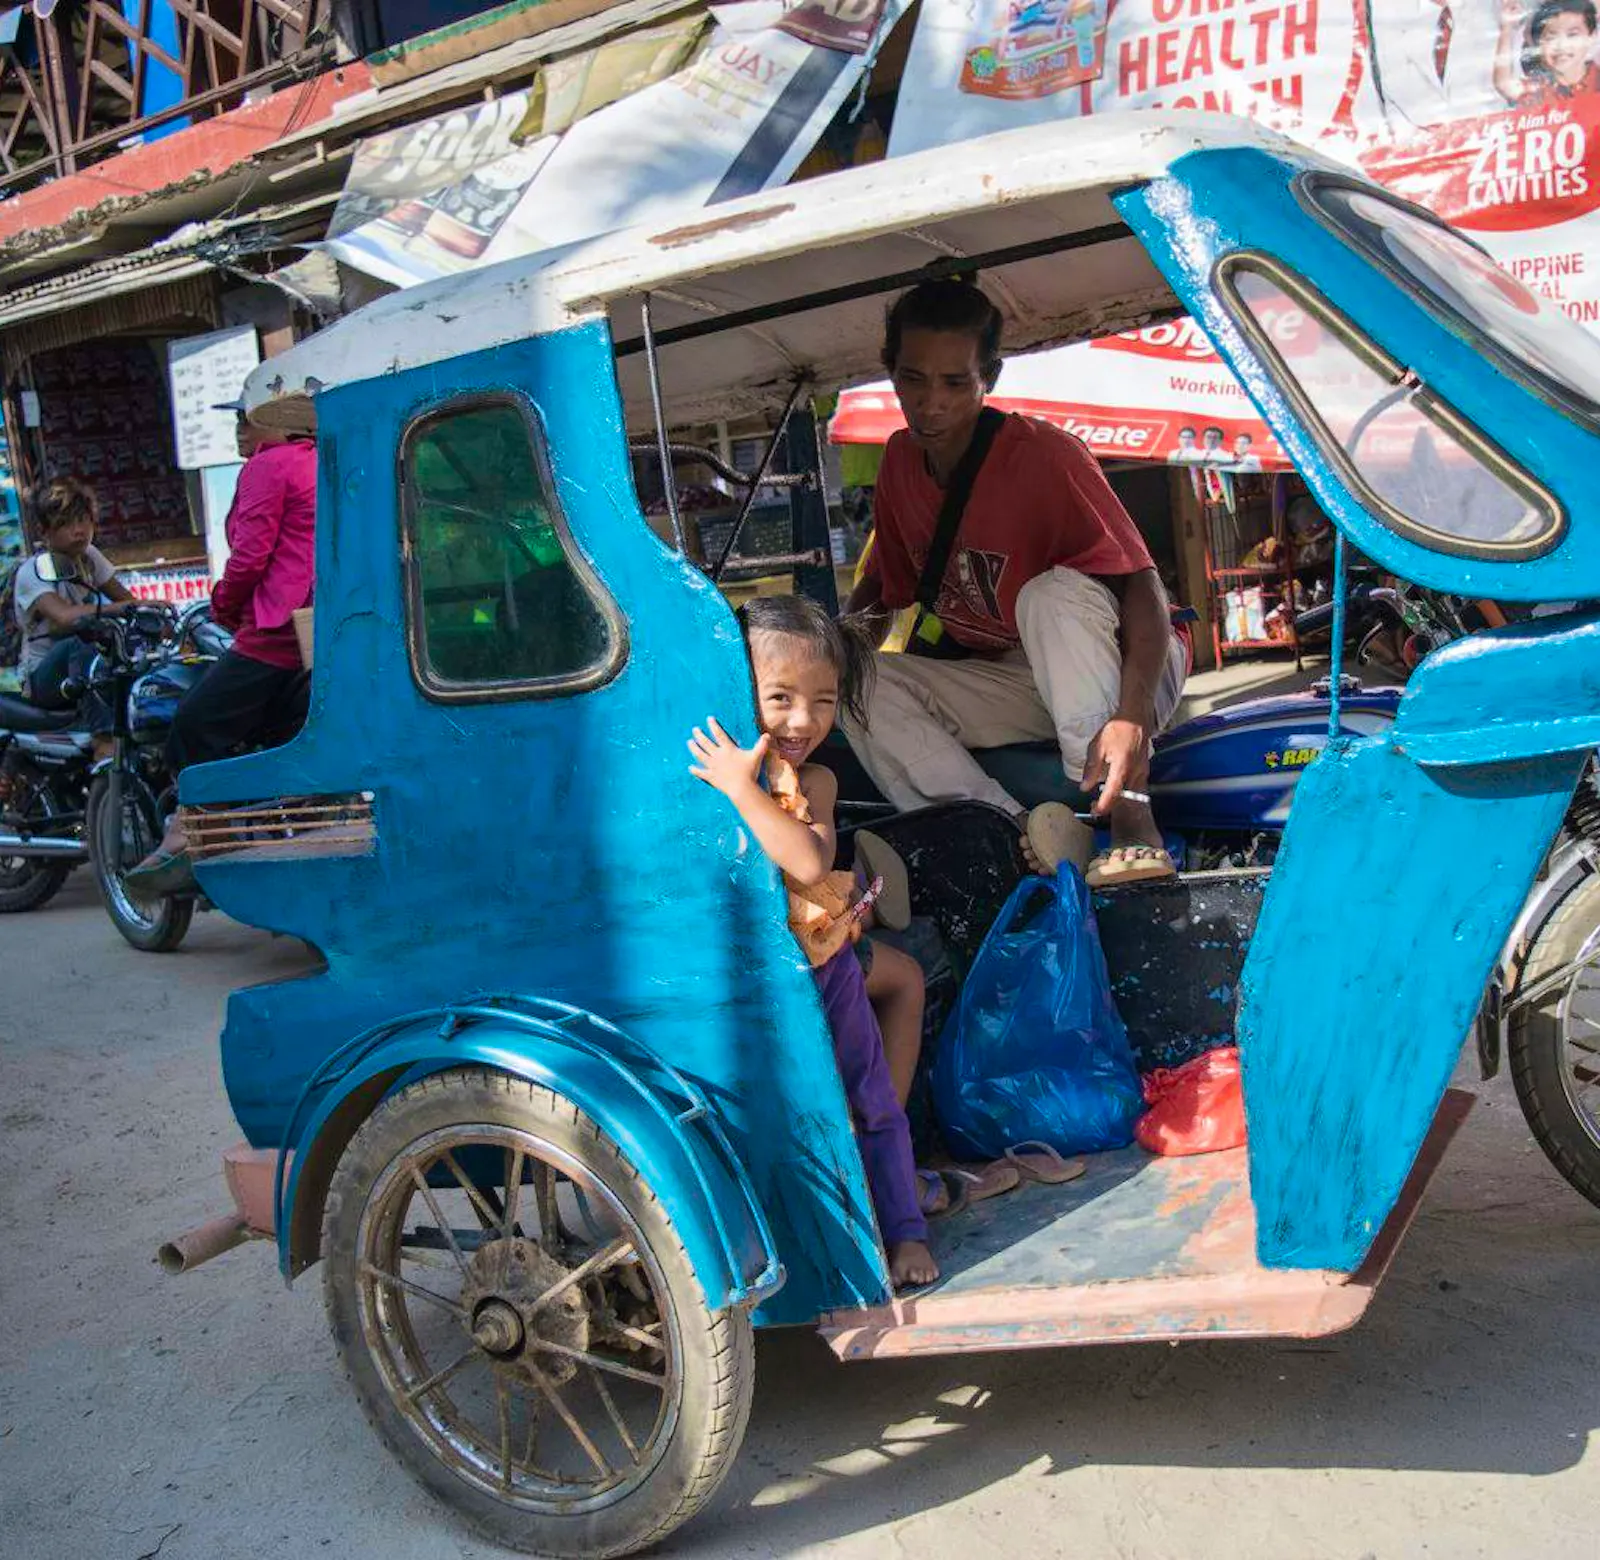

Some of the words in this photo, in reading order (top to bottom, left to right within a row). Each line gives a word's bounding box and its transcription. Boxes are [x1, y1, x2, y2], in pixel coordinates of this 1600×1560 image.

[1118, 1, 1318, 97] HEALTH
[1517, 114, 1545, 131] Aim
[1467, 122, 1586, 184] ZERO
[1467, 166, 1589, 209] CAVITIES
[1497, 252, 1584, 280] IPPINE
